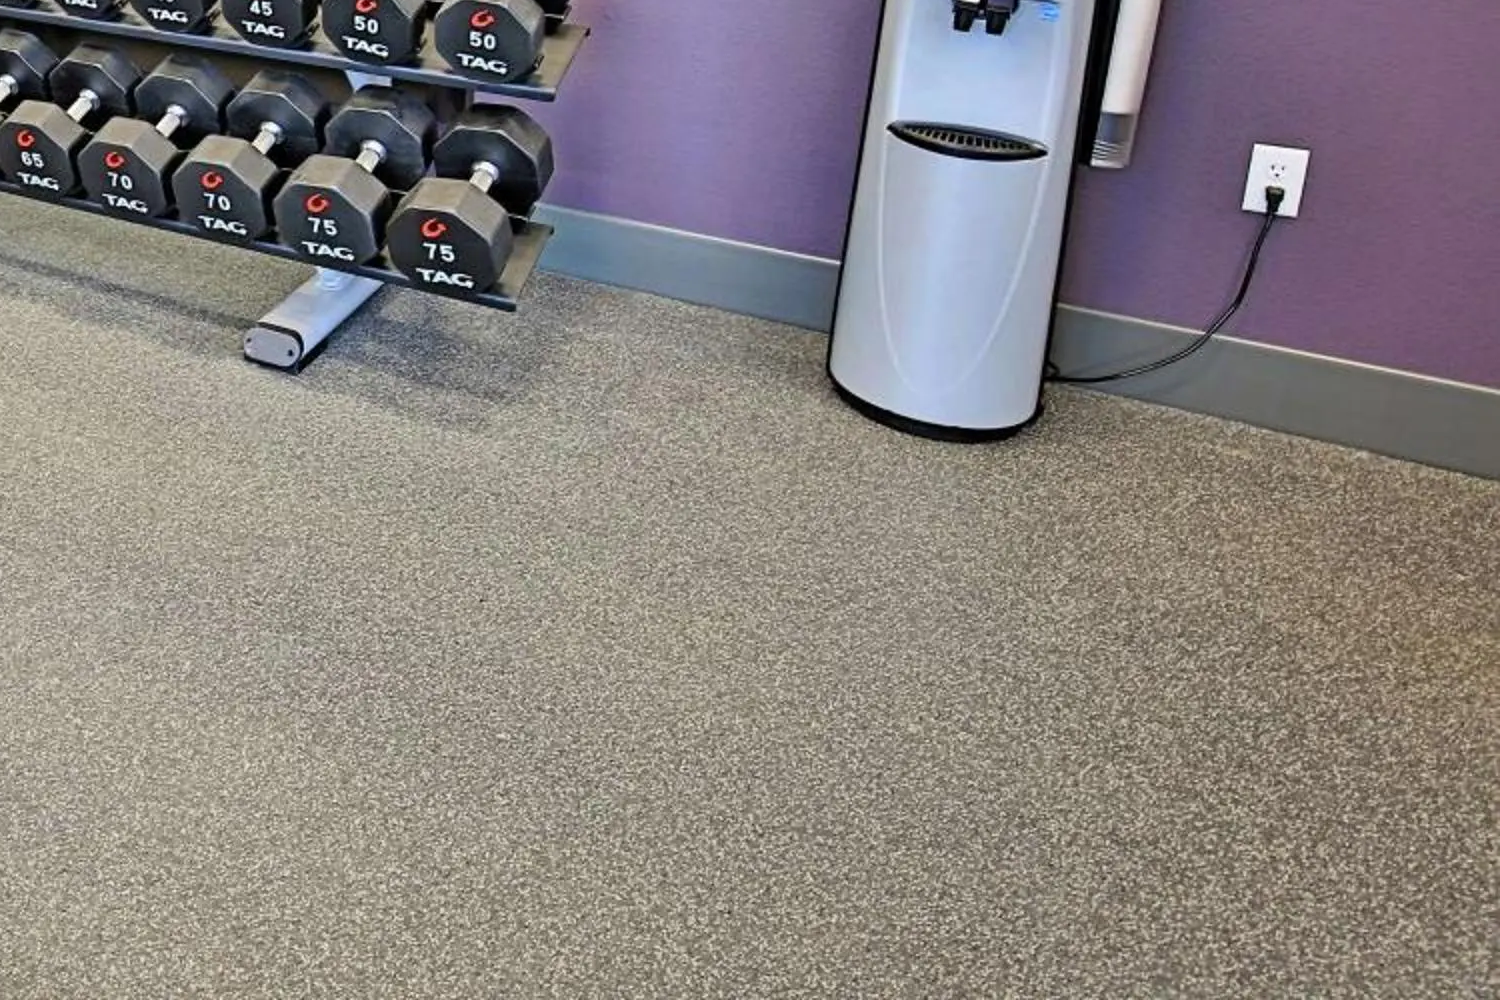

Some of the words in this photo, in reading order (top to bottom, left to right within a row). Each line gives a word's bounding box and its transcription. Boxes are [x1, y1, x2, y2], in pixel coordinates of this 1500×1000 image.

[148, 7, 188, 22] TAG
[250, 0, 273, 16] 45
[241, 20, 285, 38] TAG
[354, 16, 379, 34] 50
[342, 35, 389, 57] TAG
[470, 32, 496, 50] 50
[456, 53, 507, 75] TAG
[21, 151, 44, 168] 65
[17, 171, 59, 191] TAG
[107, 172, 133, 191] 70
[101, 193, 148, 214] TAG
[204, 193, 231, 211] 70
[198, 215, 247, 236] TAG
[308, 217, 338, 236] 75
[301, 241, 355, 261] TAG
[423, 243, 455, 262] 75
[416, 267, 475, 289] TAG
